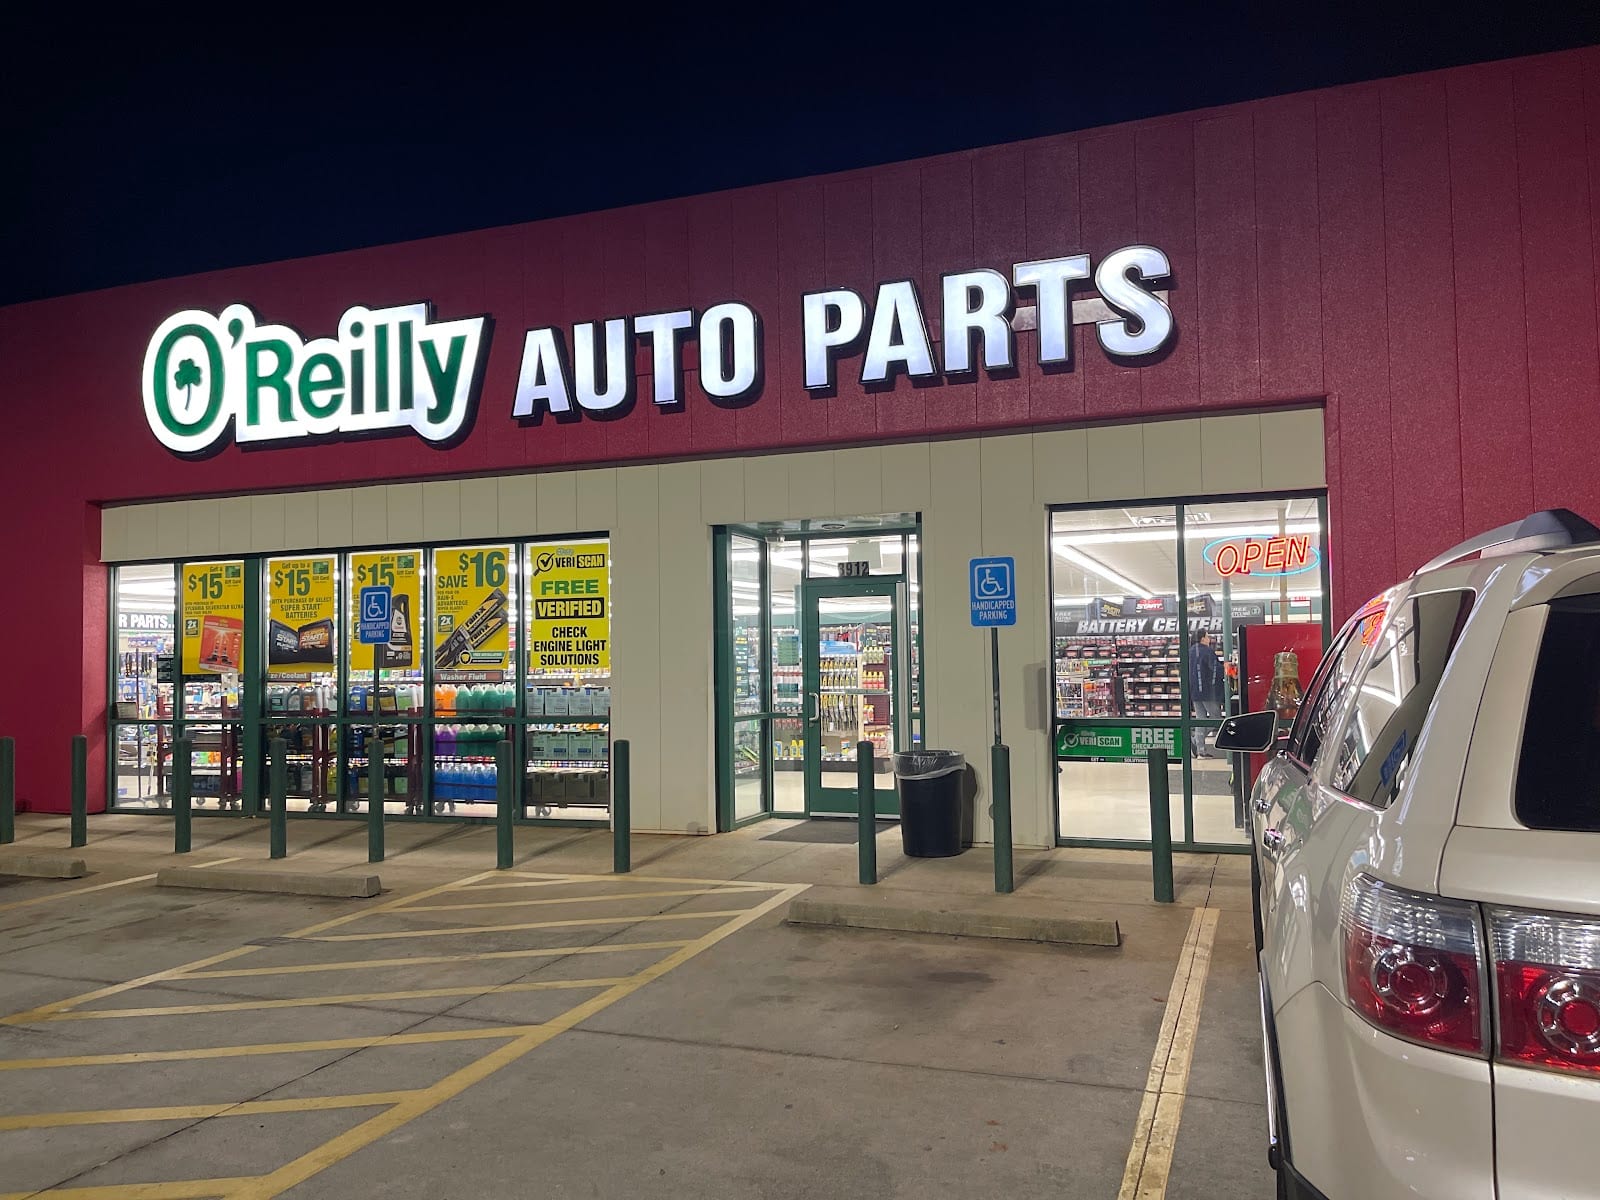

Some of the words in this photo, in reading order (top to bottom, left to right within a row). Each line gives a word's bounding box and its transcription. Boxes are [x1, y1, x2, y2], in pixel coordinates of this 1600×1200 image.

[150, 316, 472, 441] O'Reilly
[512, 302, 757, 417] AUTO
[802, 245, 1173, 390] PARTS
[555, 557, 575, 568] VERI
[578, 555, 603, 568] SCAN
[1215, 535, 1309, 576] OPEN
[357, 563, 394, 588] $15
[438, 575, 468, 588] SAVE
[459, 551, 506, 587] $16
[188, 573, 223, 599] $15
[274, 569, 311, 596] $15
[541, 579, 599, 595] FREE
[537, 600, 602, 617] VERIFIED
[971, 600, 1015, 611] HANDICAPPED
[285, 611, 318, 619] BATTERIES
[979, 610, 1008, 621] PARKING
[361, 621, 390, 631] HANDICAPPED
[1077, 618, 1149, 634] BATTERY
[1152, 616, 1223, 633] CETER
[365, 630, 385, 638] PARKING
[551, 626, 588, 639] CHECK
[533, 640, 573, 652] ENGINE
[575, 639, 607, 652] LIGHT
[540, 653, 599, 666] SOLUTIONS
[1080, 737, 1097, 746] VERI
[1099, 737, 1120, 746] SCAN
[1131, 728, 1175, 744] FREE
